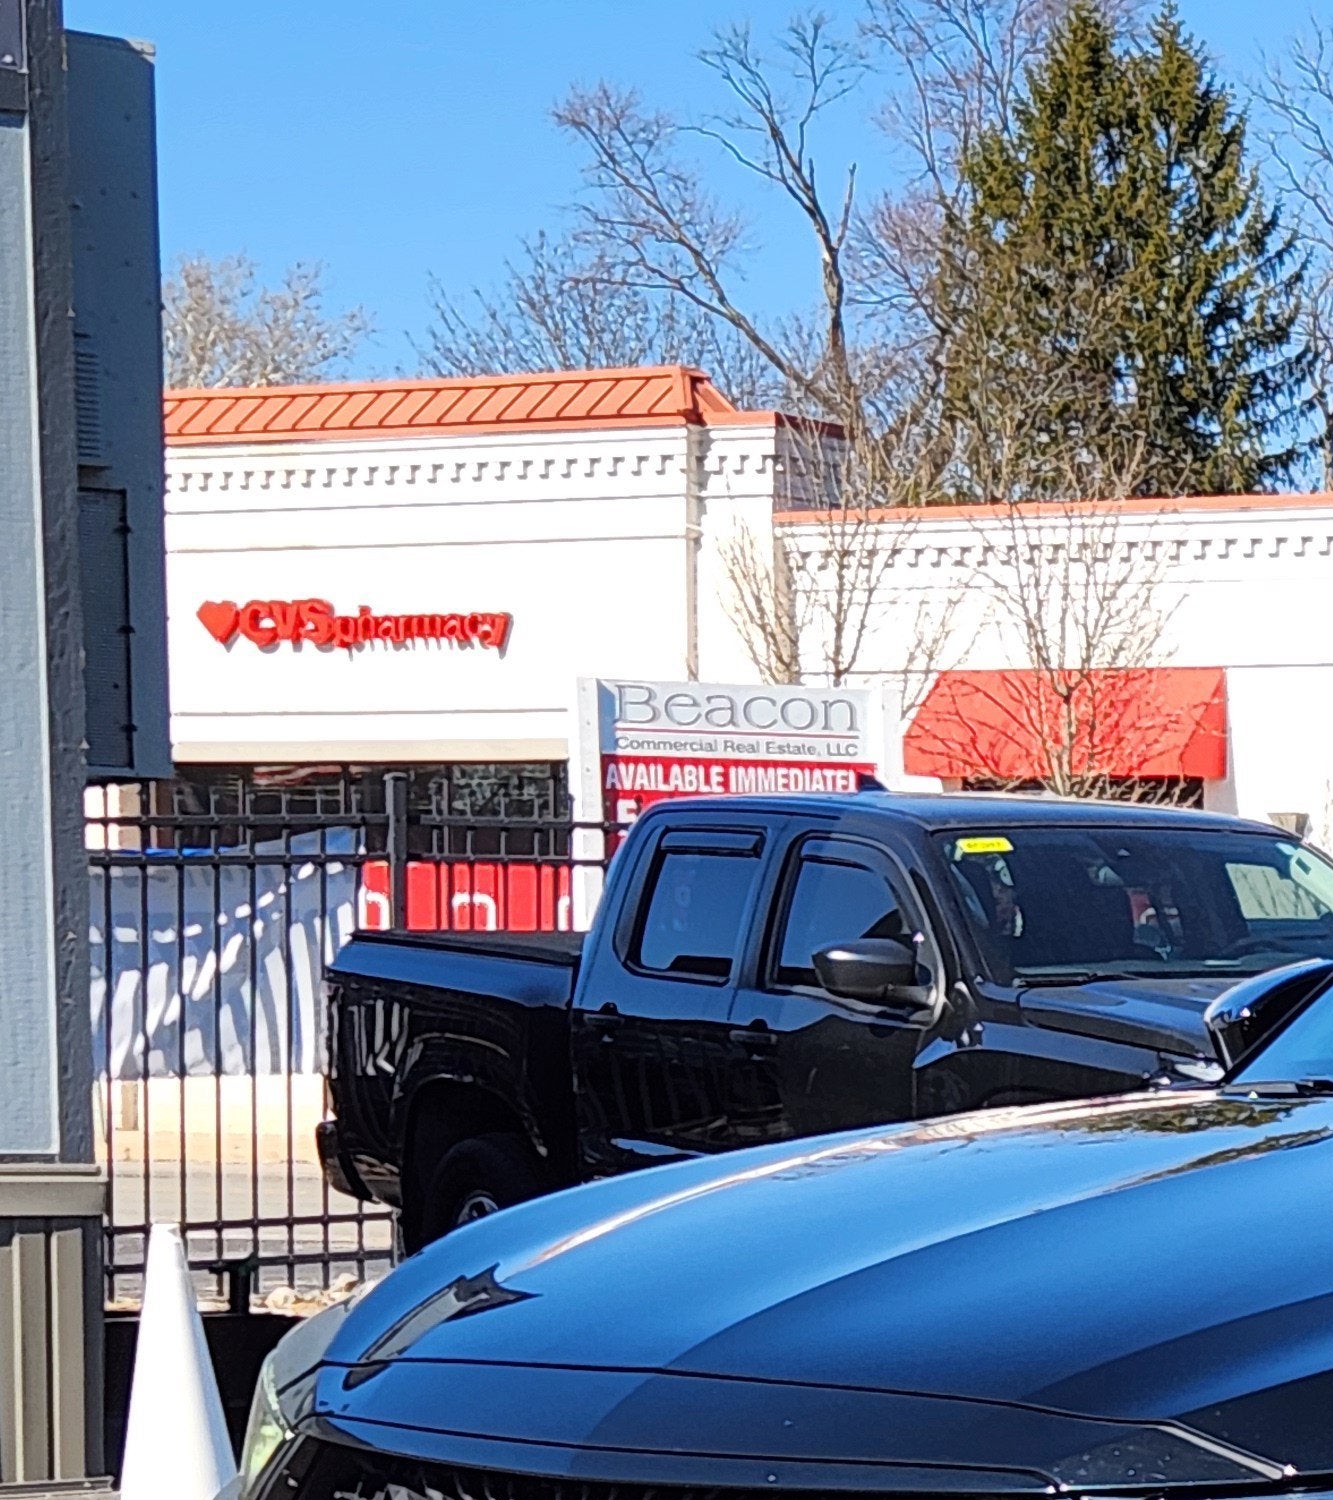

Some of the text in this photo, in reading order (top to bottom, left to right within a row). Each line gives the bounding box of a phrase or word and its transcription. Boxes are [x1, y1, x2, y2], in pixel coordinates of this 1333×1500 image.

[240, 599, 513, 648] CVS pharmacy
[614, 684, 862, 732] Beacon
[616, 736, 859, 757] Commercial Real Estate, LLC
[606, 762, 724, 793] AVAILABLE
